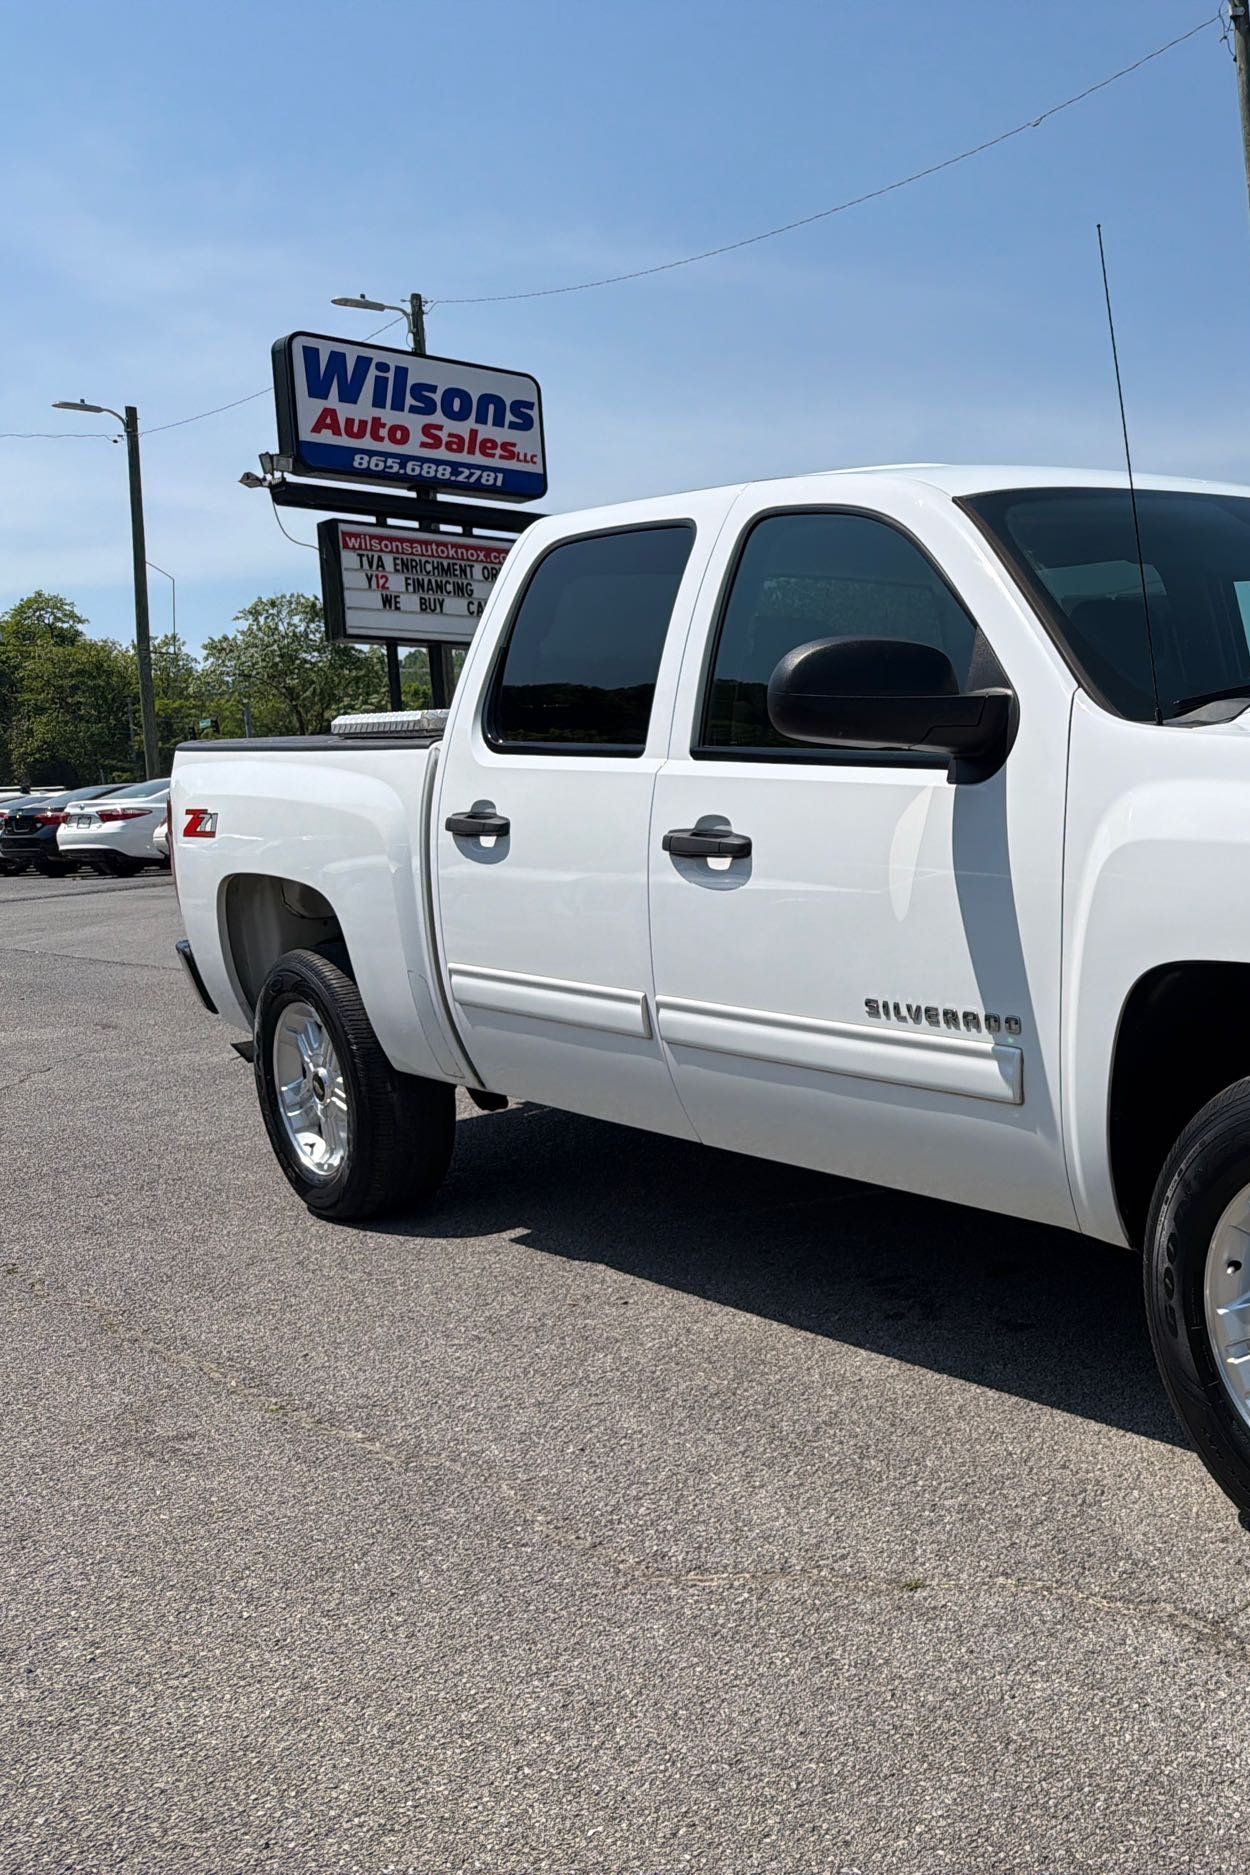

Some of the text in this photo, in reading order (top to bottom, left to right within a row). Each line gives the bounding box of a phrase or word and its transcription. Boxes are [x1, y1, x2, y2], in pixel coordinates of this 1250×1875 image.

[302, 345, 535, 432] Wilsons
[310, 407, 538, 465] Auto Sales LLC
[353, 453, 504, 487] 865.688.2781
[357, 553, 502, 581] TVA ENRICHMENT OR
[365, 572, 474, 597] Y12 FINANCING
[381, 593, 487, 617] WE BUY CA
[182, 808, 219, 838] Z71
[865, 998, 1022, 1036] SILVERADO
